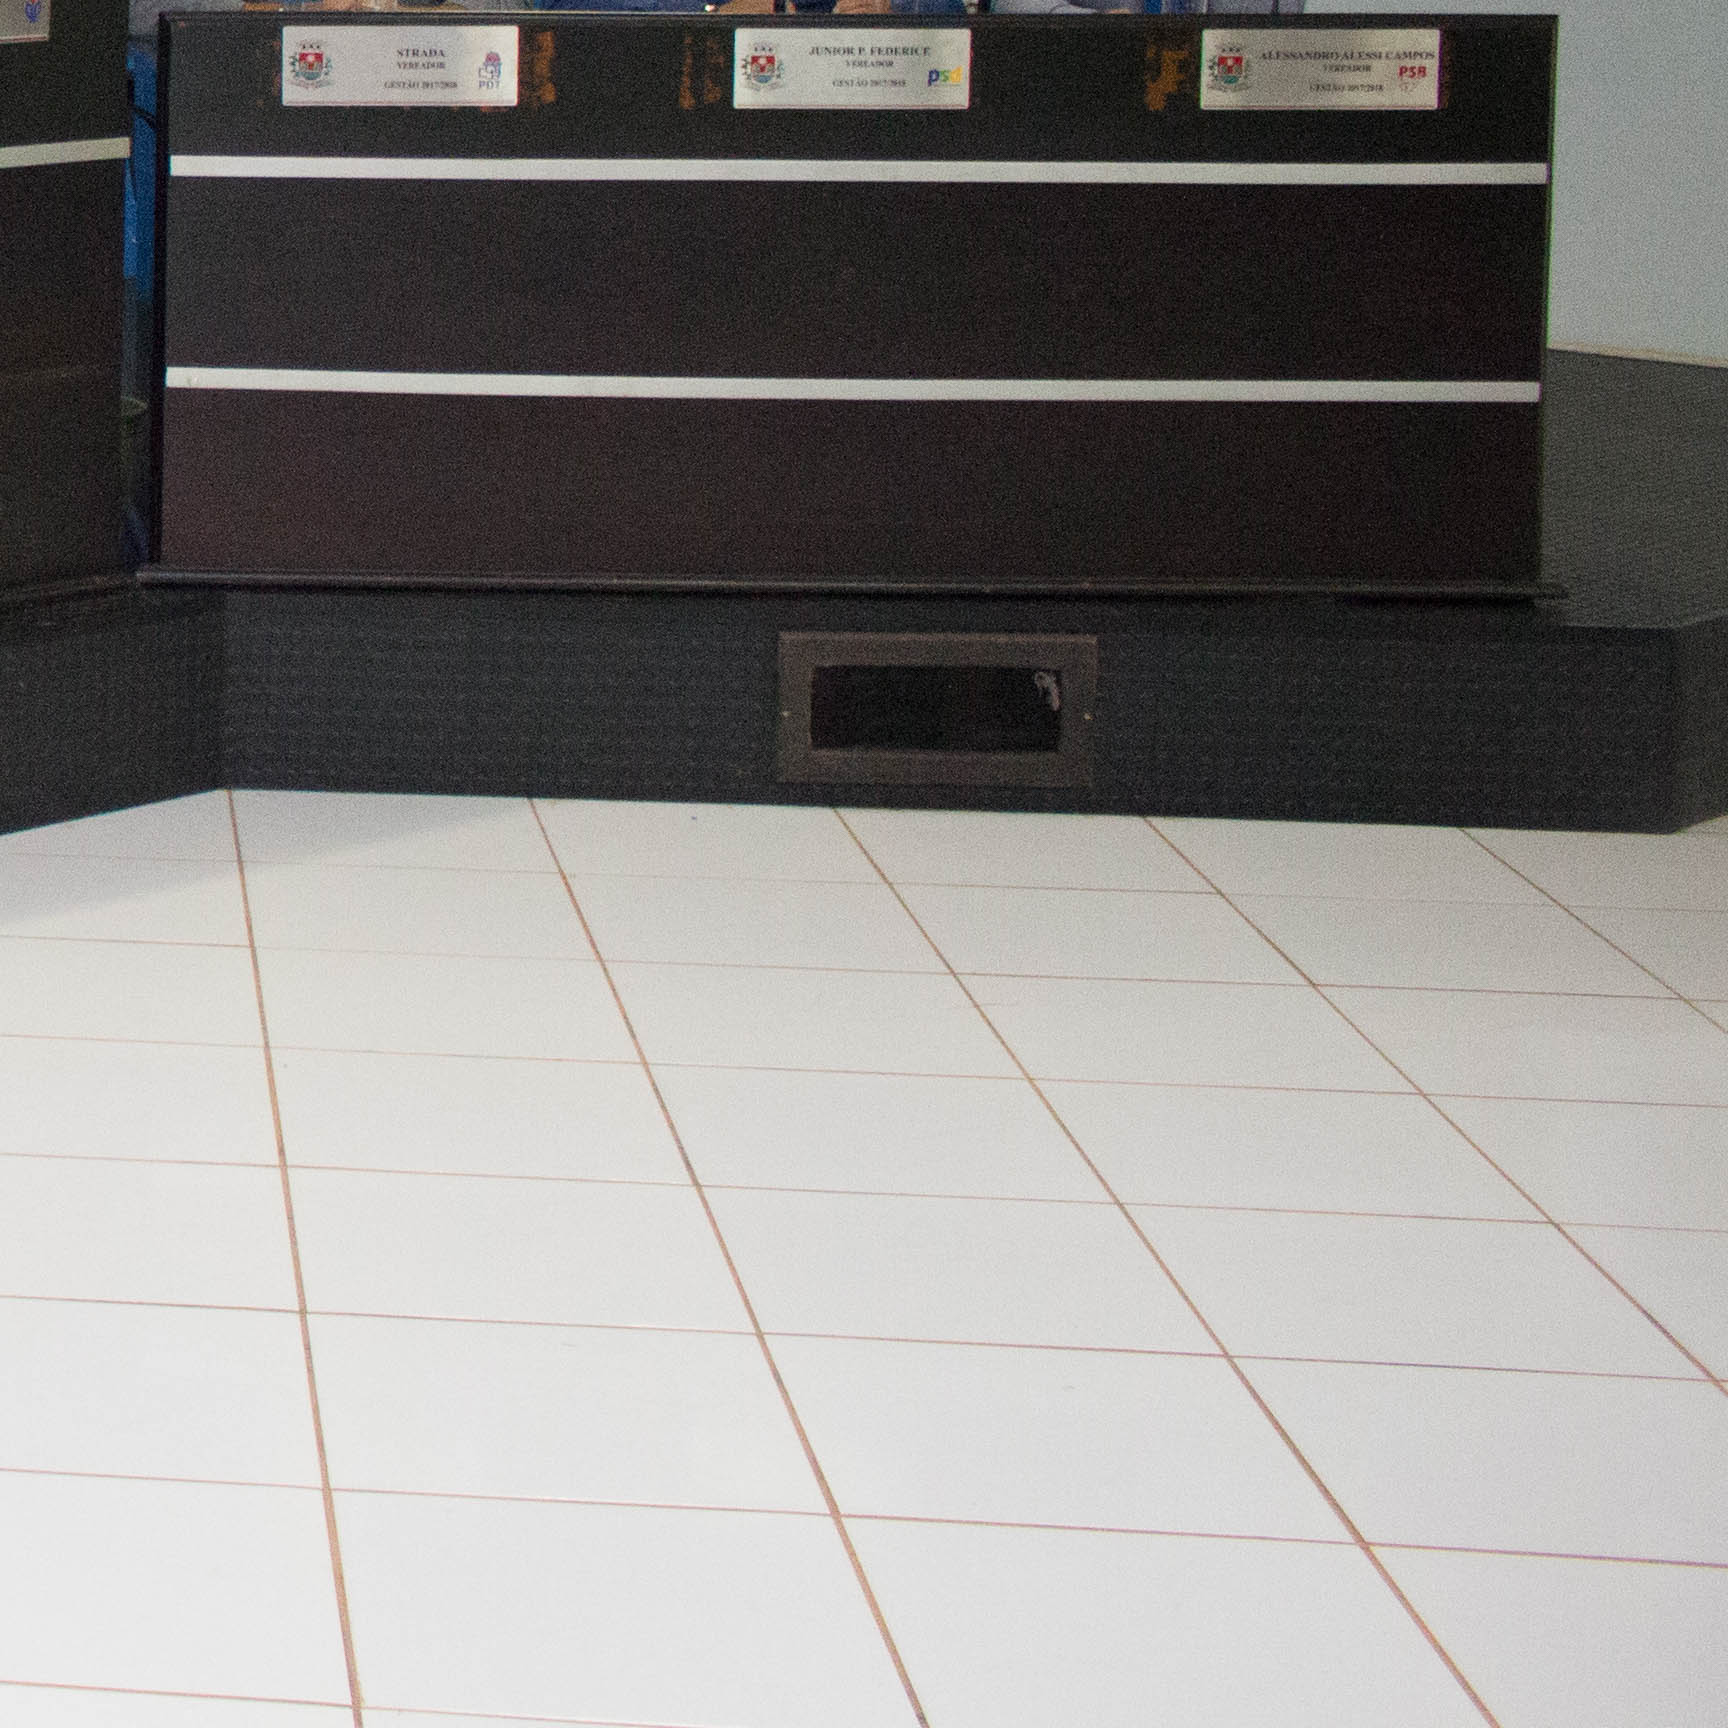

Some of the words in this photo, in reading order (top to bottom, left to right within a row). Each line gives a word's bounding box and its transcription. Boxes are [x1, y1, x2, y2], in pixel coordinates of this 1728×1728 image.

[396, 48, 446, 58] STRADA
[809, 46, 855, 57] JUNIOR
[1384, 50, 1436, 61] CAMPOS
